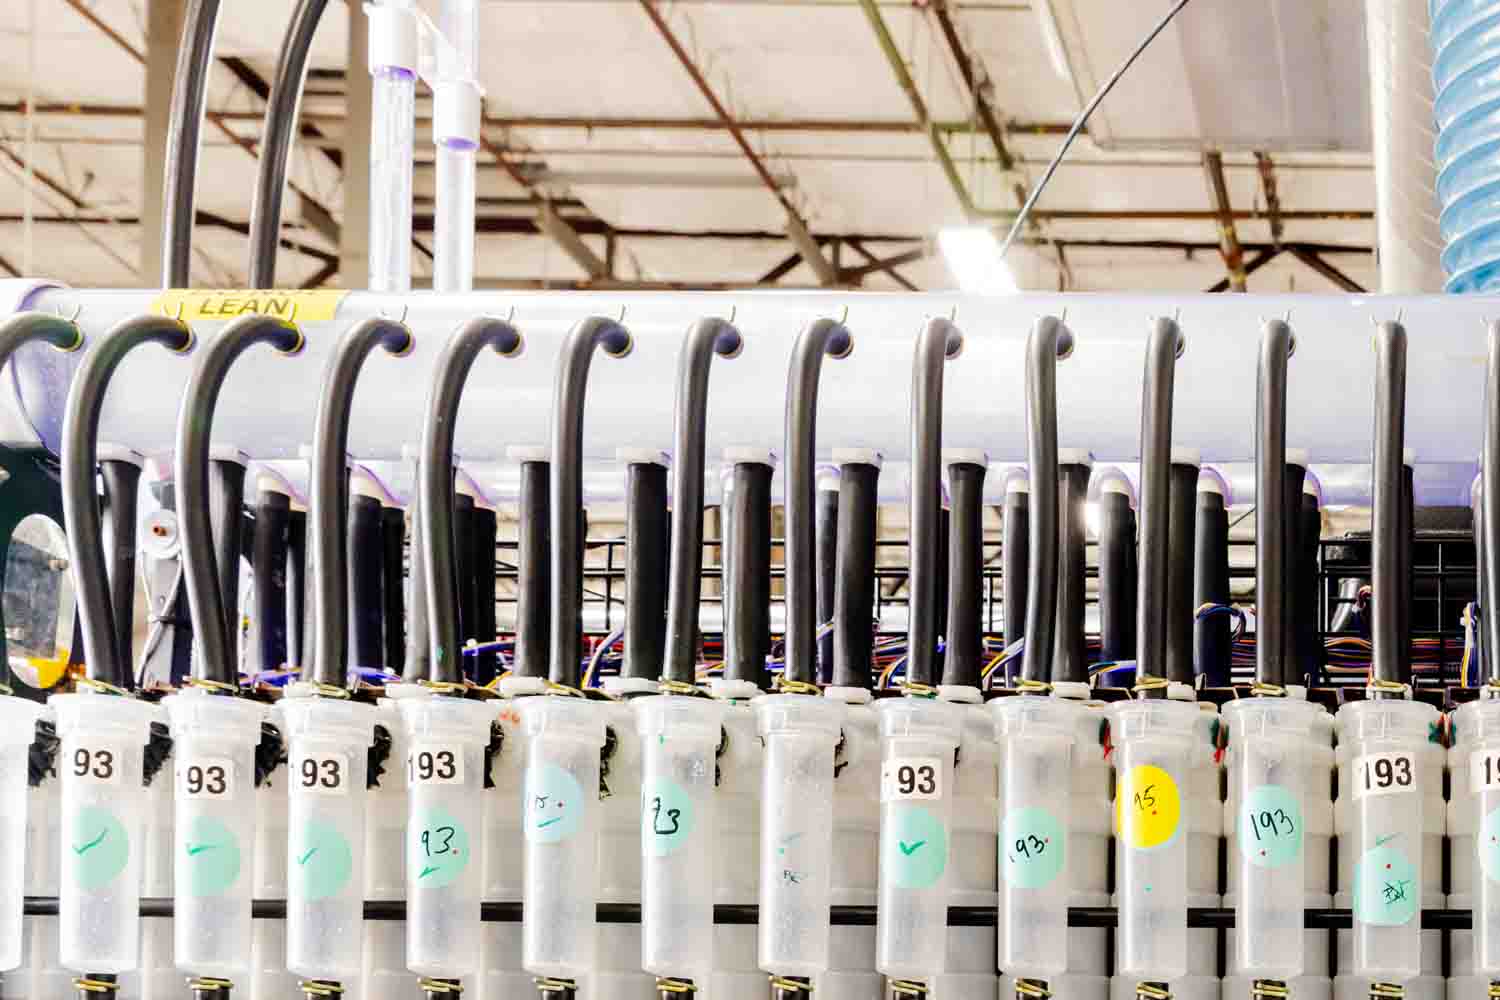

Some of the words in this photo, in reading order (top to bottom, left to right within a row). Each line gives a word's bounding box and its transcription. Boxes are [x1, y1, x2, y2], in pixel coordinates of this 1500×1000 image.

[200, 298, 290, 315] LEAN
[178, 765, 227, 795] 93
[292, 758, 342, 788] 93
[886, 765, 937, 795] 93
[1366, 757, 1413, 790] 193
[1250, 809, 1295, 840] 193
